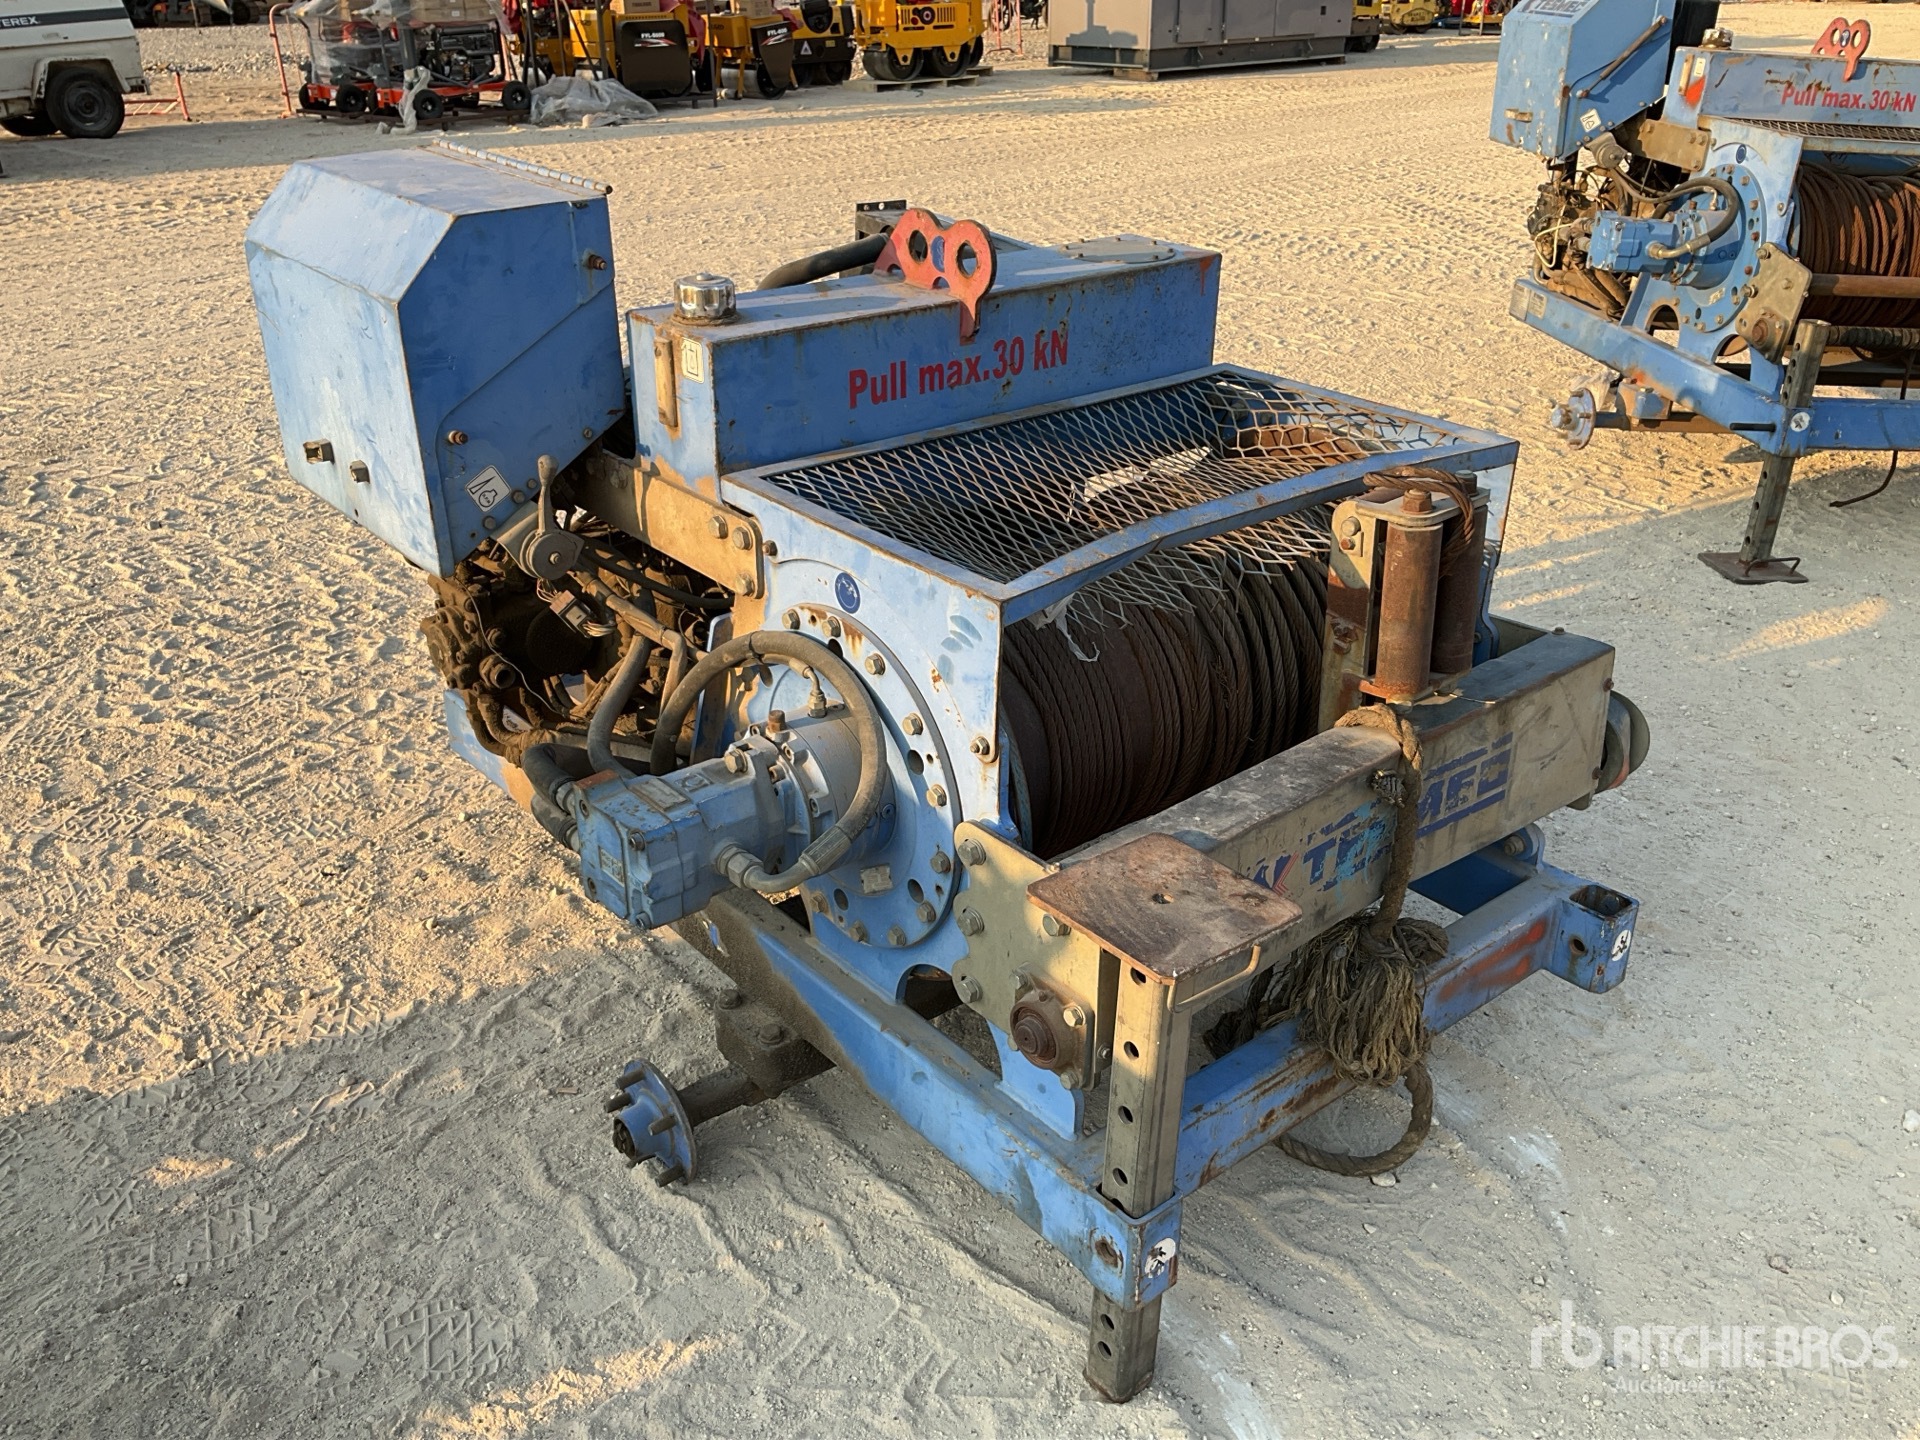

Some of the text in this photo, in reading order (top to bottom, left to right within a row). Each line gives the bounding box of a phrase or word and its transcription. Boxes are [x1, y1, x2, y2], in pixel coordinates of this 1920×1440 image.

[0, 16, 39, 27] EREX
[1781, 82, 1818, 106] Pull
[1892, 90, 1917, 112] kN
[848, 360, 907, 409] Pull
[1033, 329, 1069, 371] kN
